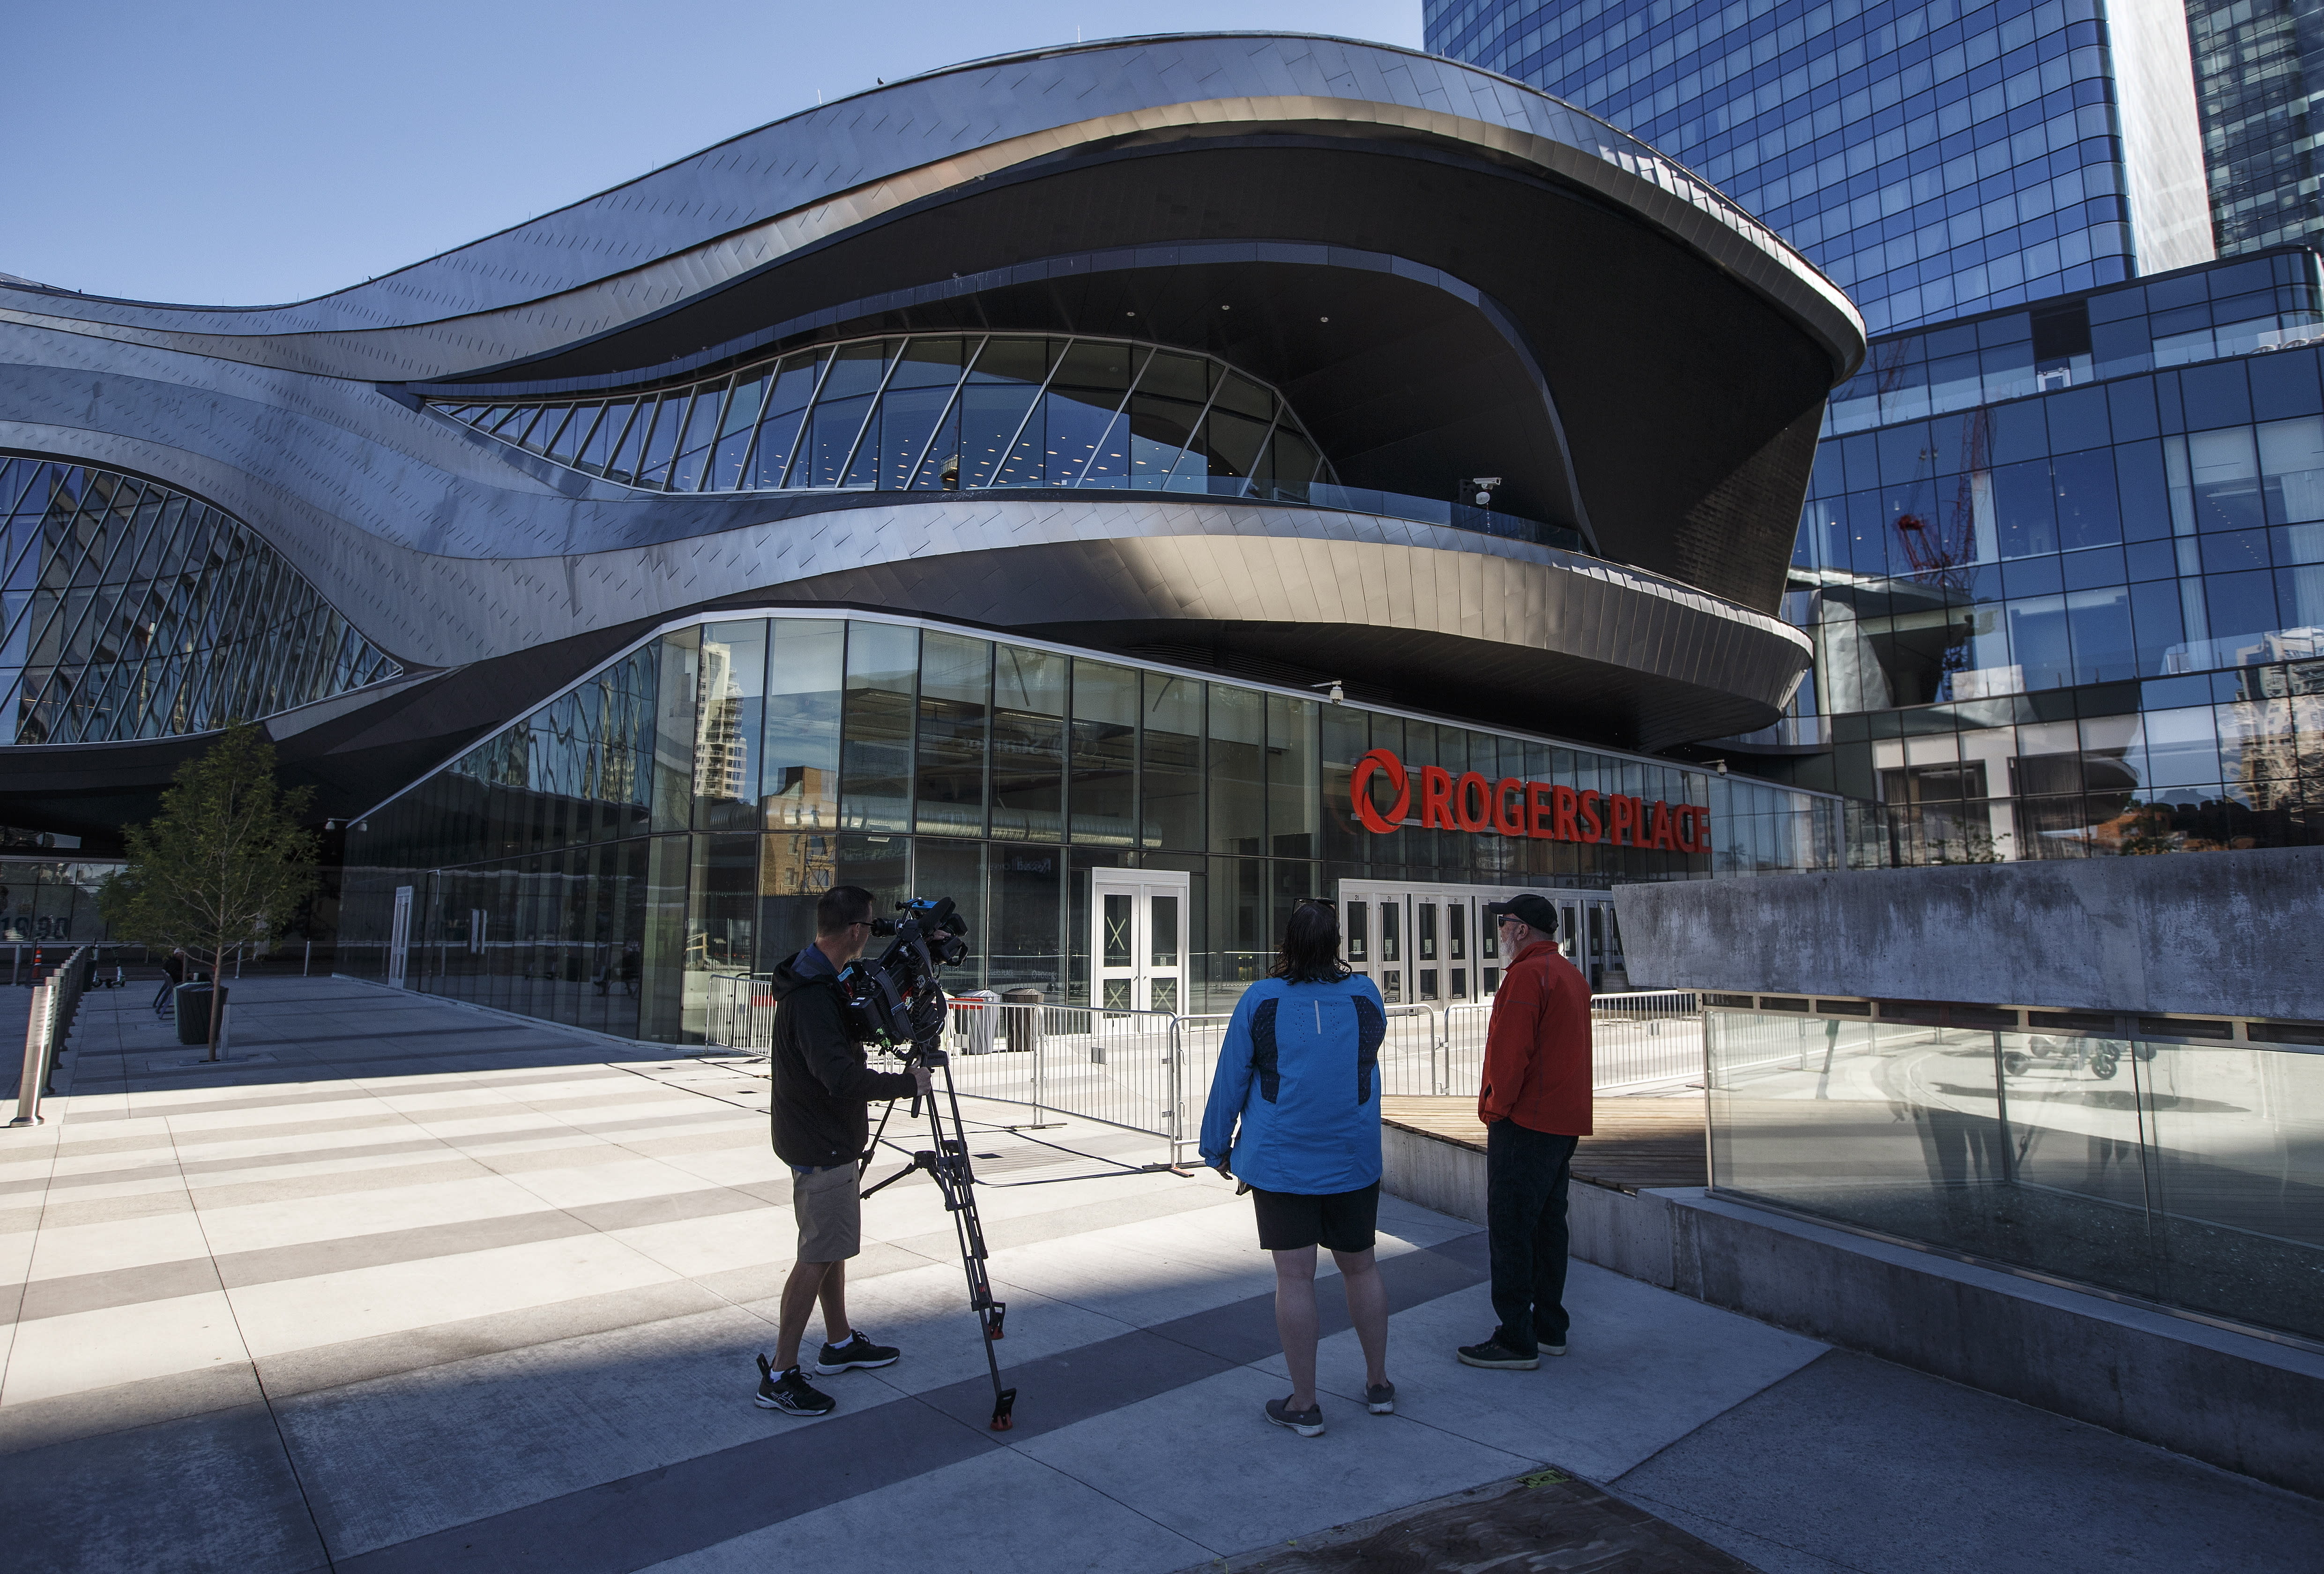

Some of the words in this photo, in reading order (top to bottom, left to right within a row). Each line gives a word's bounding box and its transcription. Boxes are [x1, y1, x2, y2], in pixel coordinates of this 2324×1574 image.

[1421, 766, 1601, 843] ROGERS
[1610, 793, 1713, 854] PLACE
[1037, 970, 1058, 980] ROGERS
